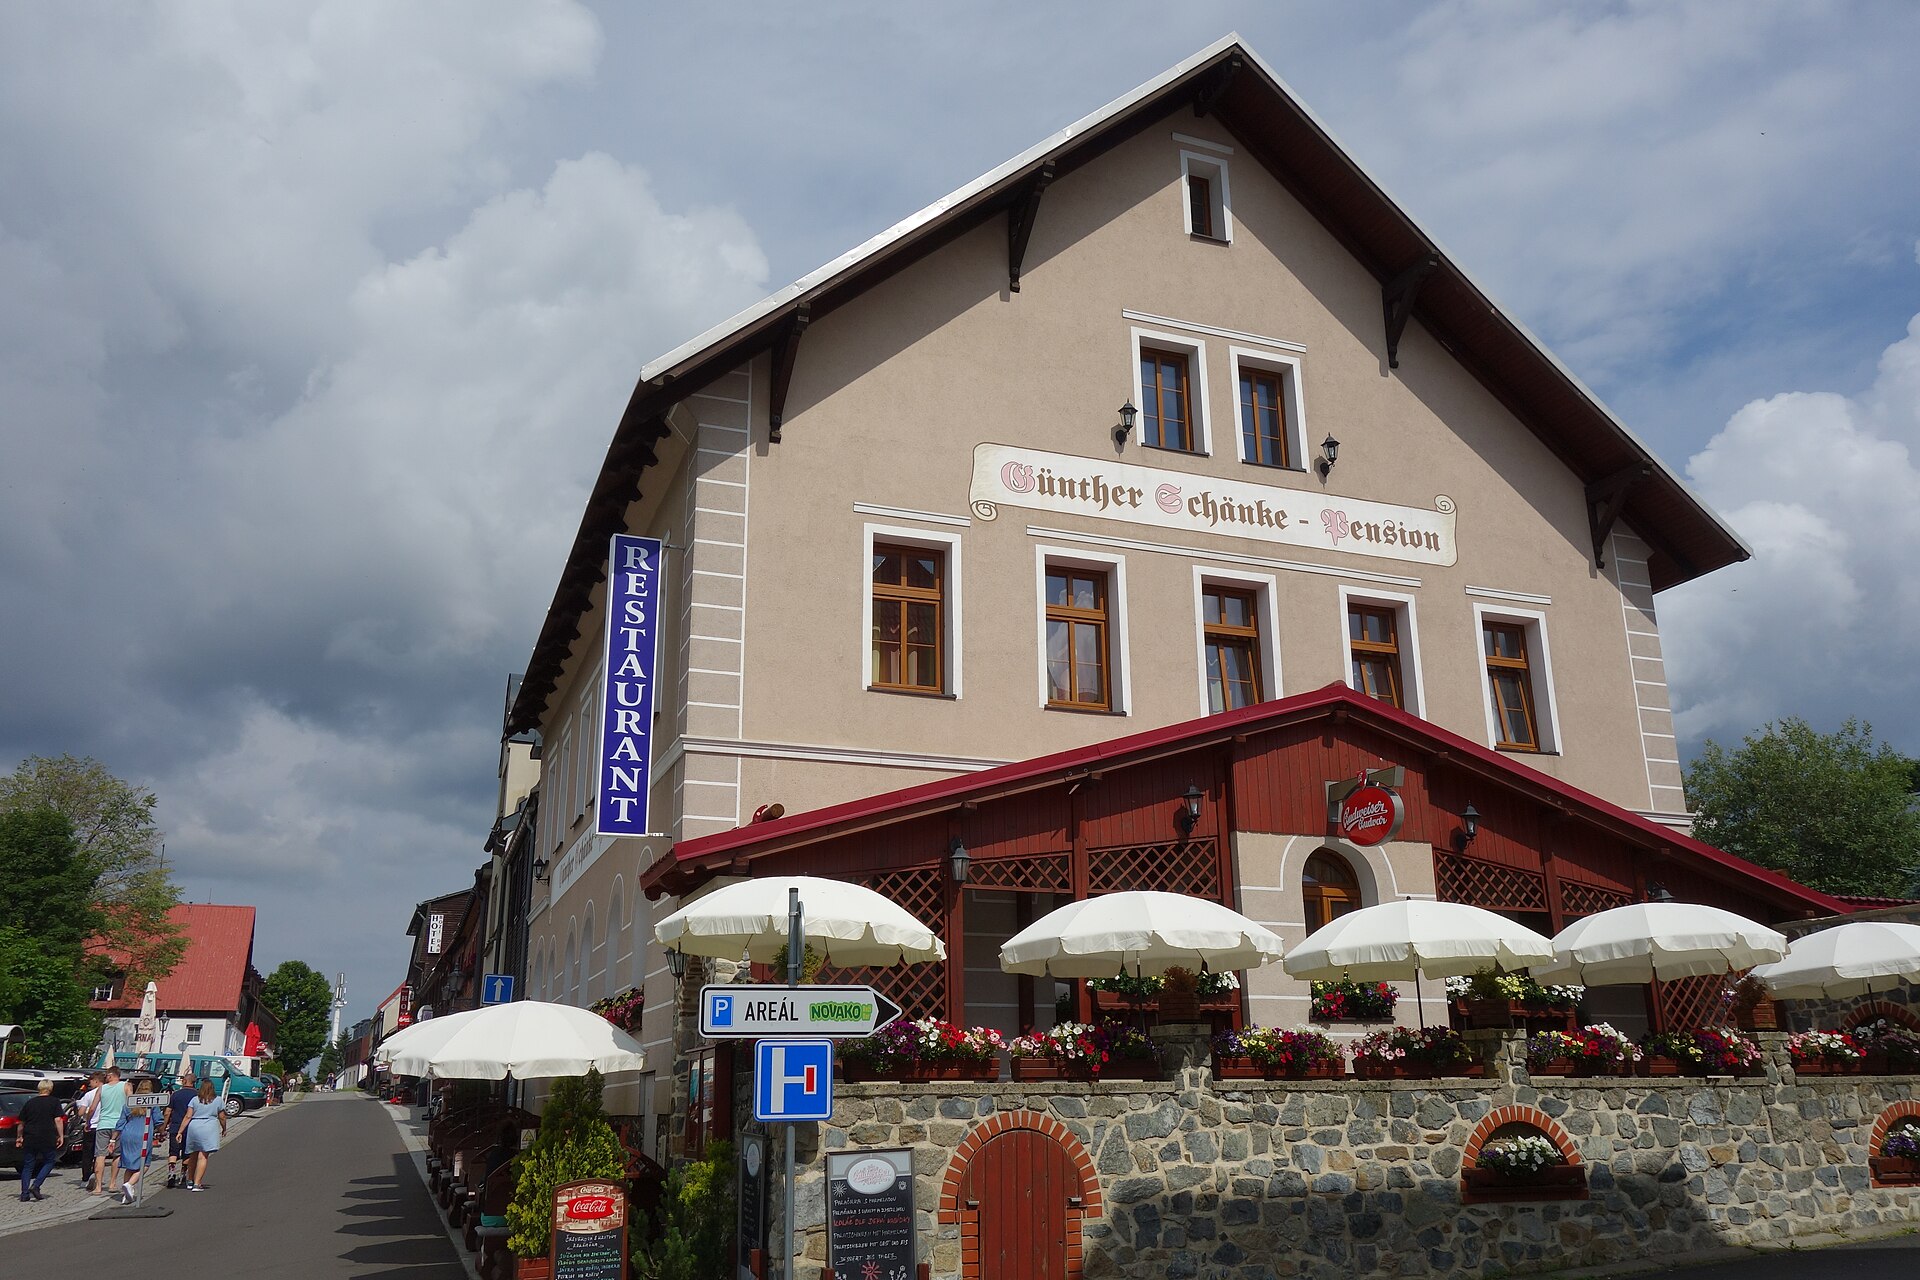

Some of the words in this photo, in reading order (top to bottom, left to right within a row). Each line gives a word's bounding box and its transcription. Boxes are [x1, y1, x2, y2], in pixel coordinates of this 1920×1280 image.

[1000, 460, 1144, 512] Günther
[1155, 483, 1288, 530] Schänke
[1320, 508, 1440, 552] Pension
[609, 545, 654, 822] RESTAURANT
[1343, 800, 1388, 829] Budweiser
[430, 915, 438, 952] HOTEL
[716, 1000, 728, 1018] P
[744, 996, 799, 1022] AREÁL
[810, 1003, 861, 1021] NOVAKO
